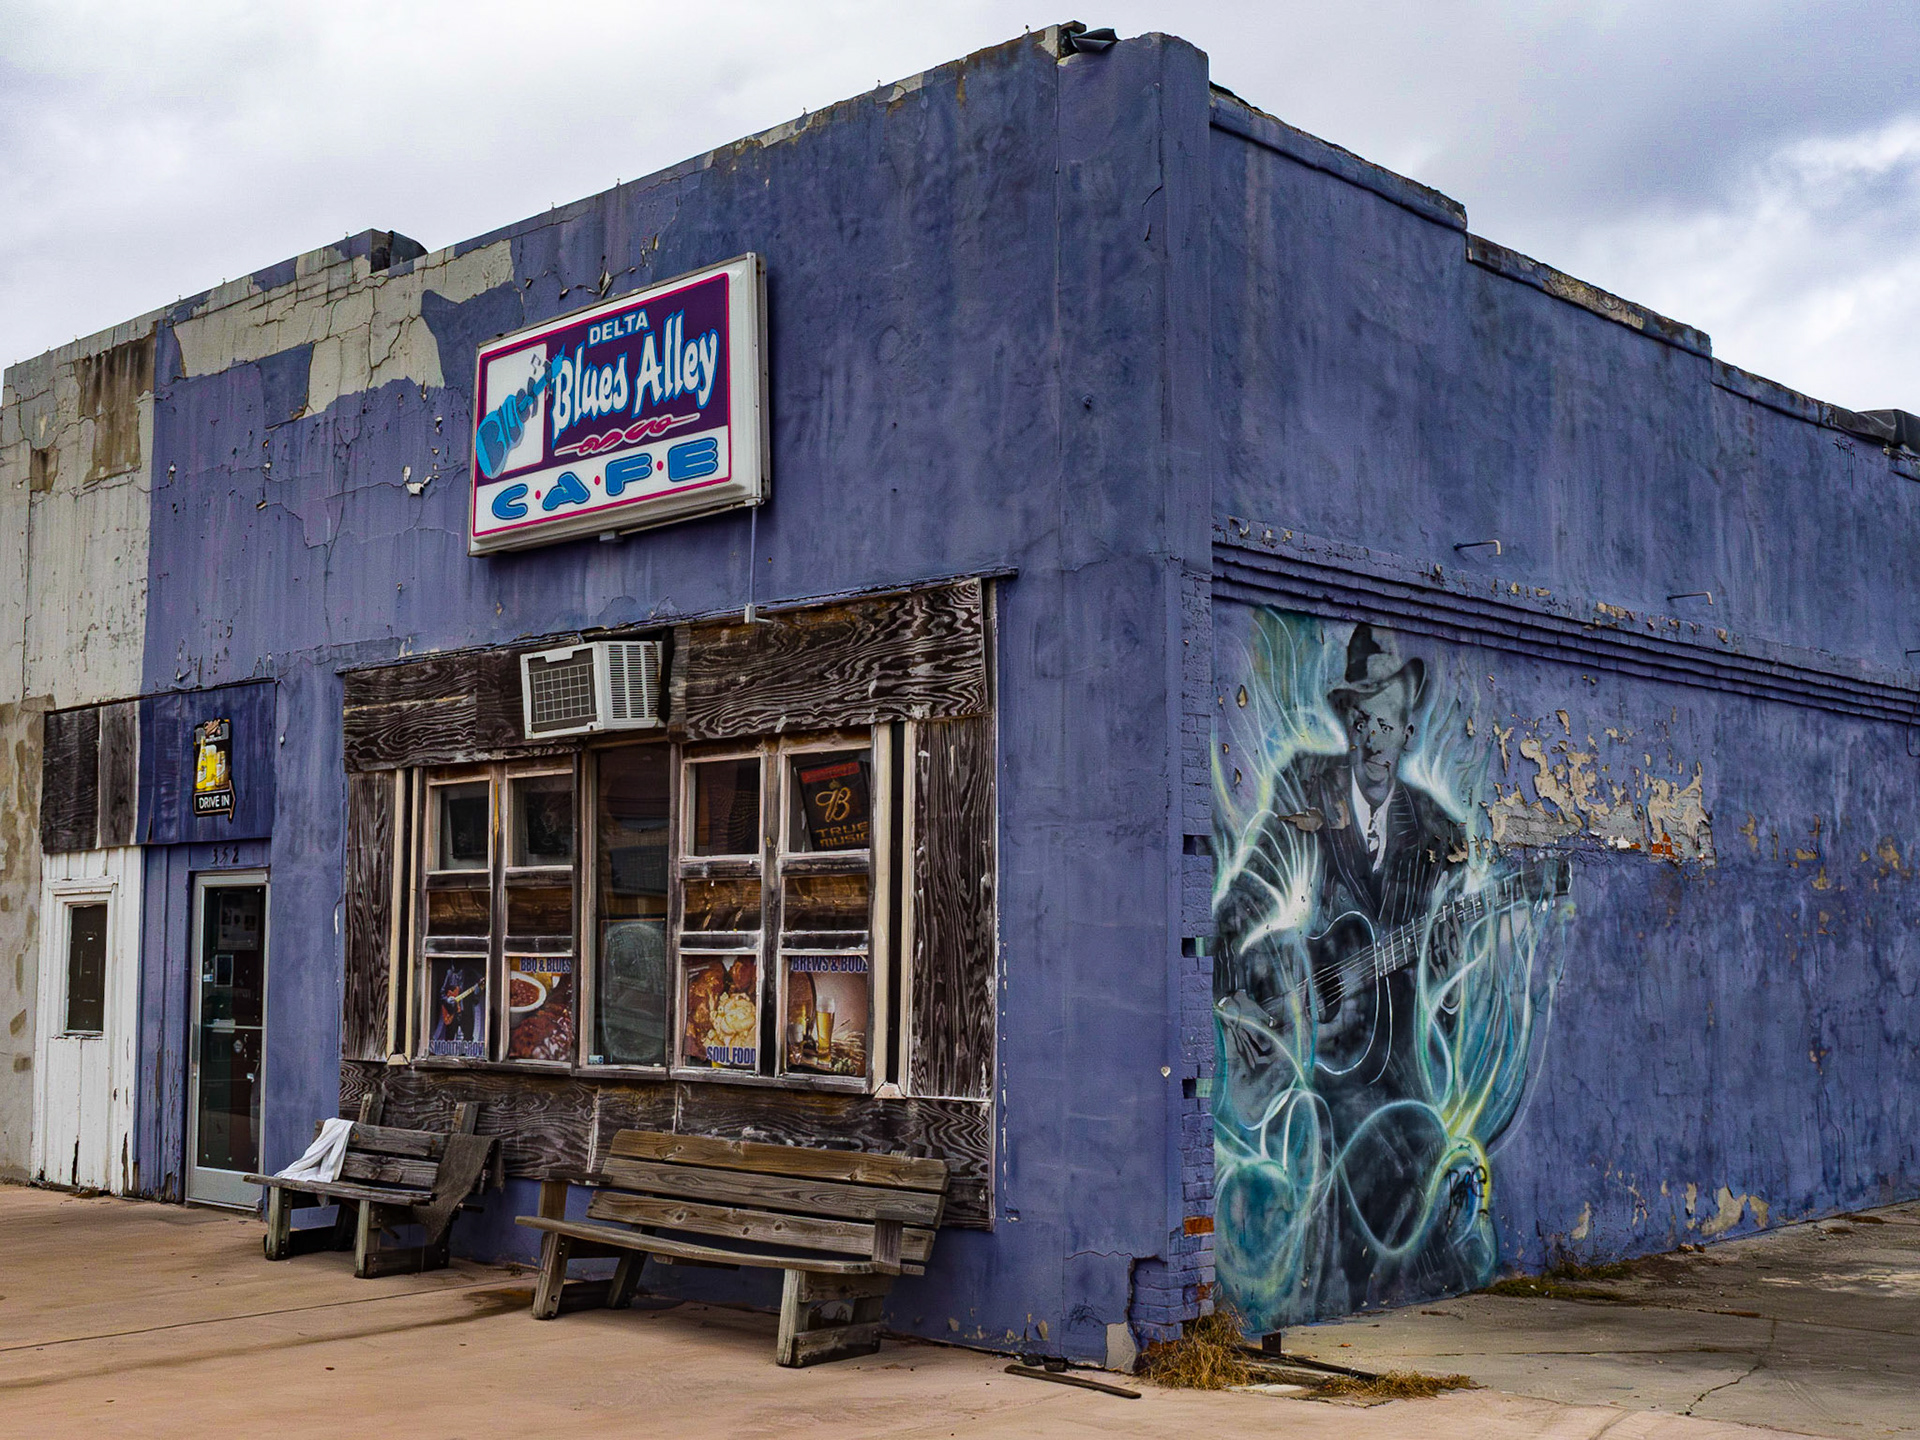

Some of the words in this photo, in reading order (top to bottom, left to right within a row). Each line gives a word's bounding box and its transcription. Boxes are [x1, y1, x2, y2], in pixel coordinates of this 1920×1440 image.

[588, 309, 650, 347] DELTA
[551, 343, 628, 446] Blues
[631, 310, 719, 416] Alley
[199, 796, 220, 809] DRIVE
[221, 794, 230, 806] IN
[815, 820, 869, 838] TRUE
[520, 957, 537, 973] BBQ
[538, 959, 547, 972] &
[547, 957, 572, 973] BLUES
[791, 956, 829, 973] BREWS
[830, 957, 839, 973] &
[706, 1045, 730, 1065] SOUL
[731, 1046, 756, 1065] FOOD
